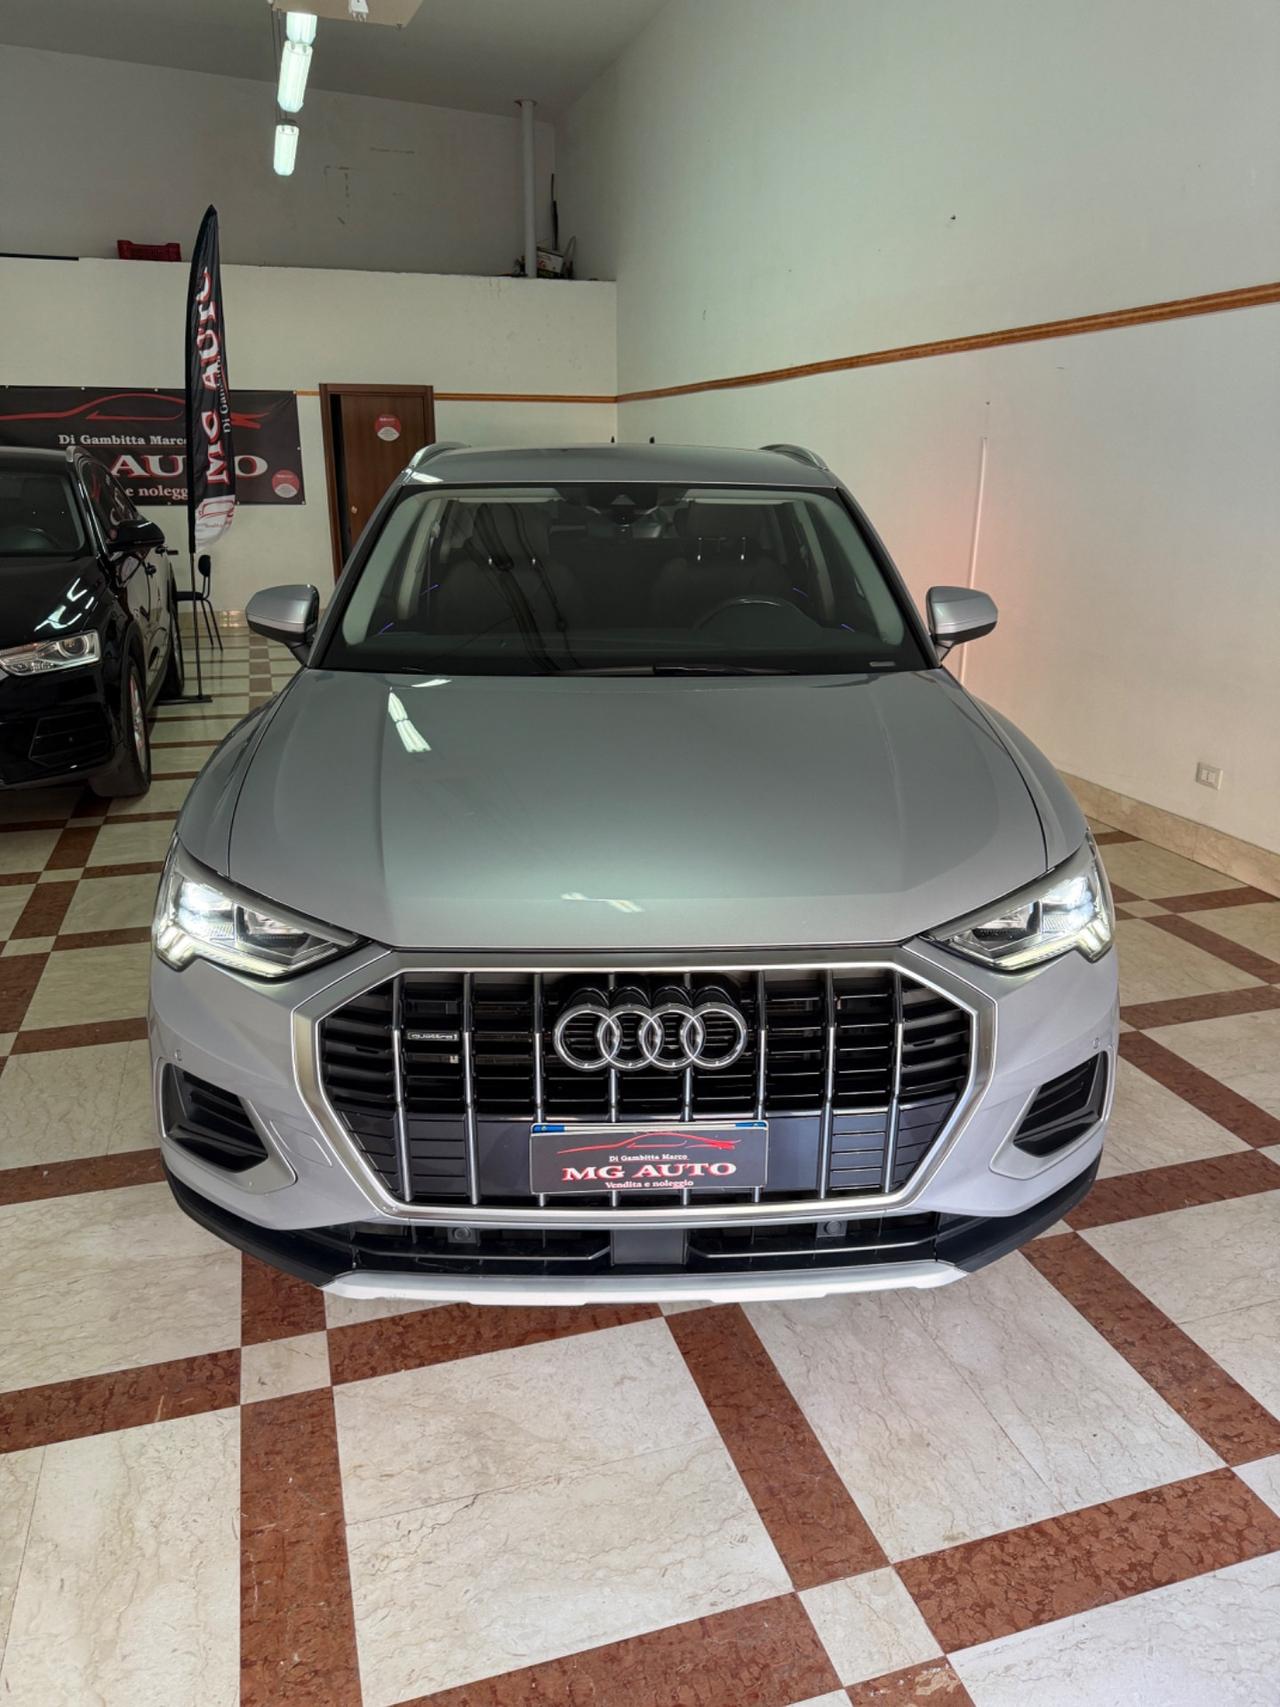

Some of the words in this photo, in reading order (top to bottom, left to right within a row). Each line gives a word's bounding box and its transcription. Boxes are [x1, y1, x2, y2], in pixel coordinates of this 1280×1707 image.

[58, 434, 75, 445] Di
[80, 434, 146, 445] Gambitta
[110, 454, 268, 477] AUO
[125, 487, 134, 496] e
[138, 485, 188, 500] nolegg
[662, 1153, 688, 1161] Marco
[562, 1165, 625, 1181] MG
[631, 1162, 737, 1178] AUTO
[605, 1181, 642, 1189] Vendita
[652, 1179, 694, 1190] noleggio
